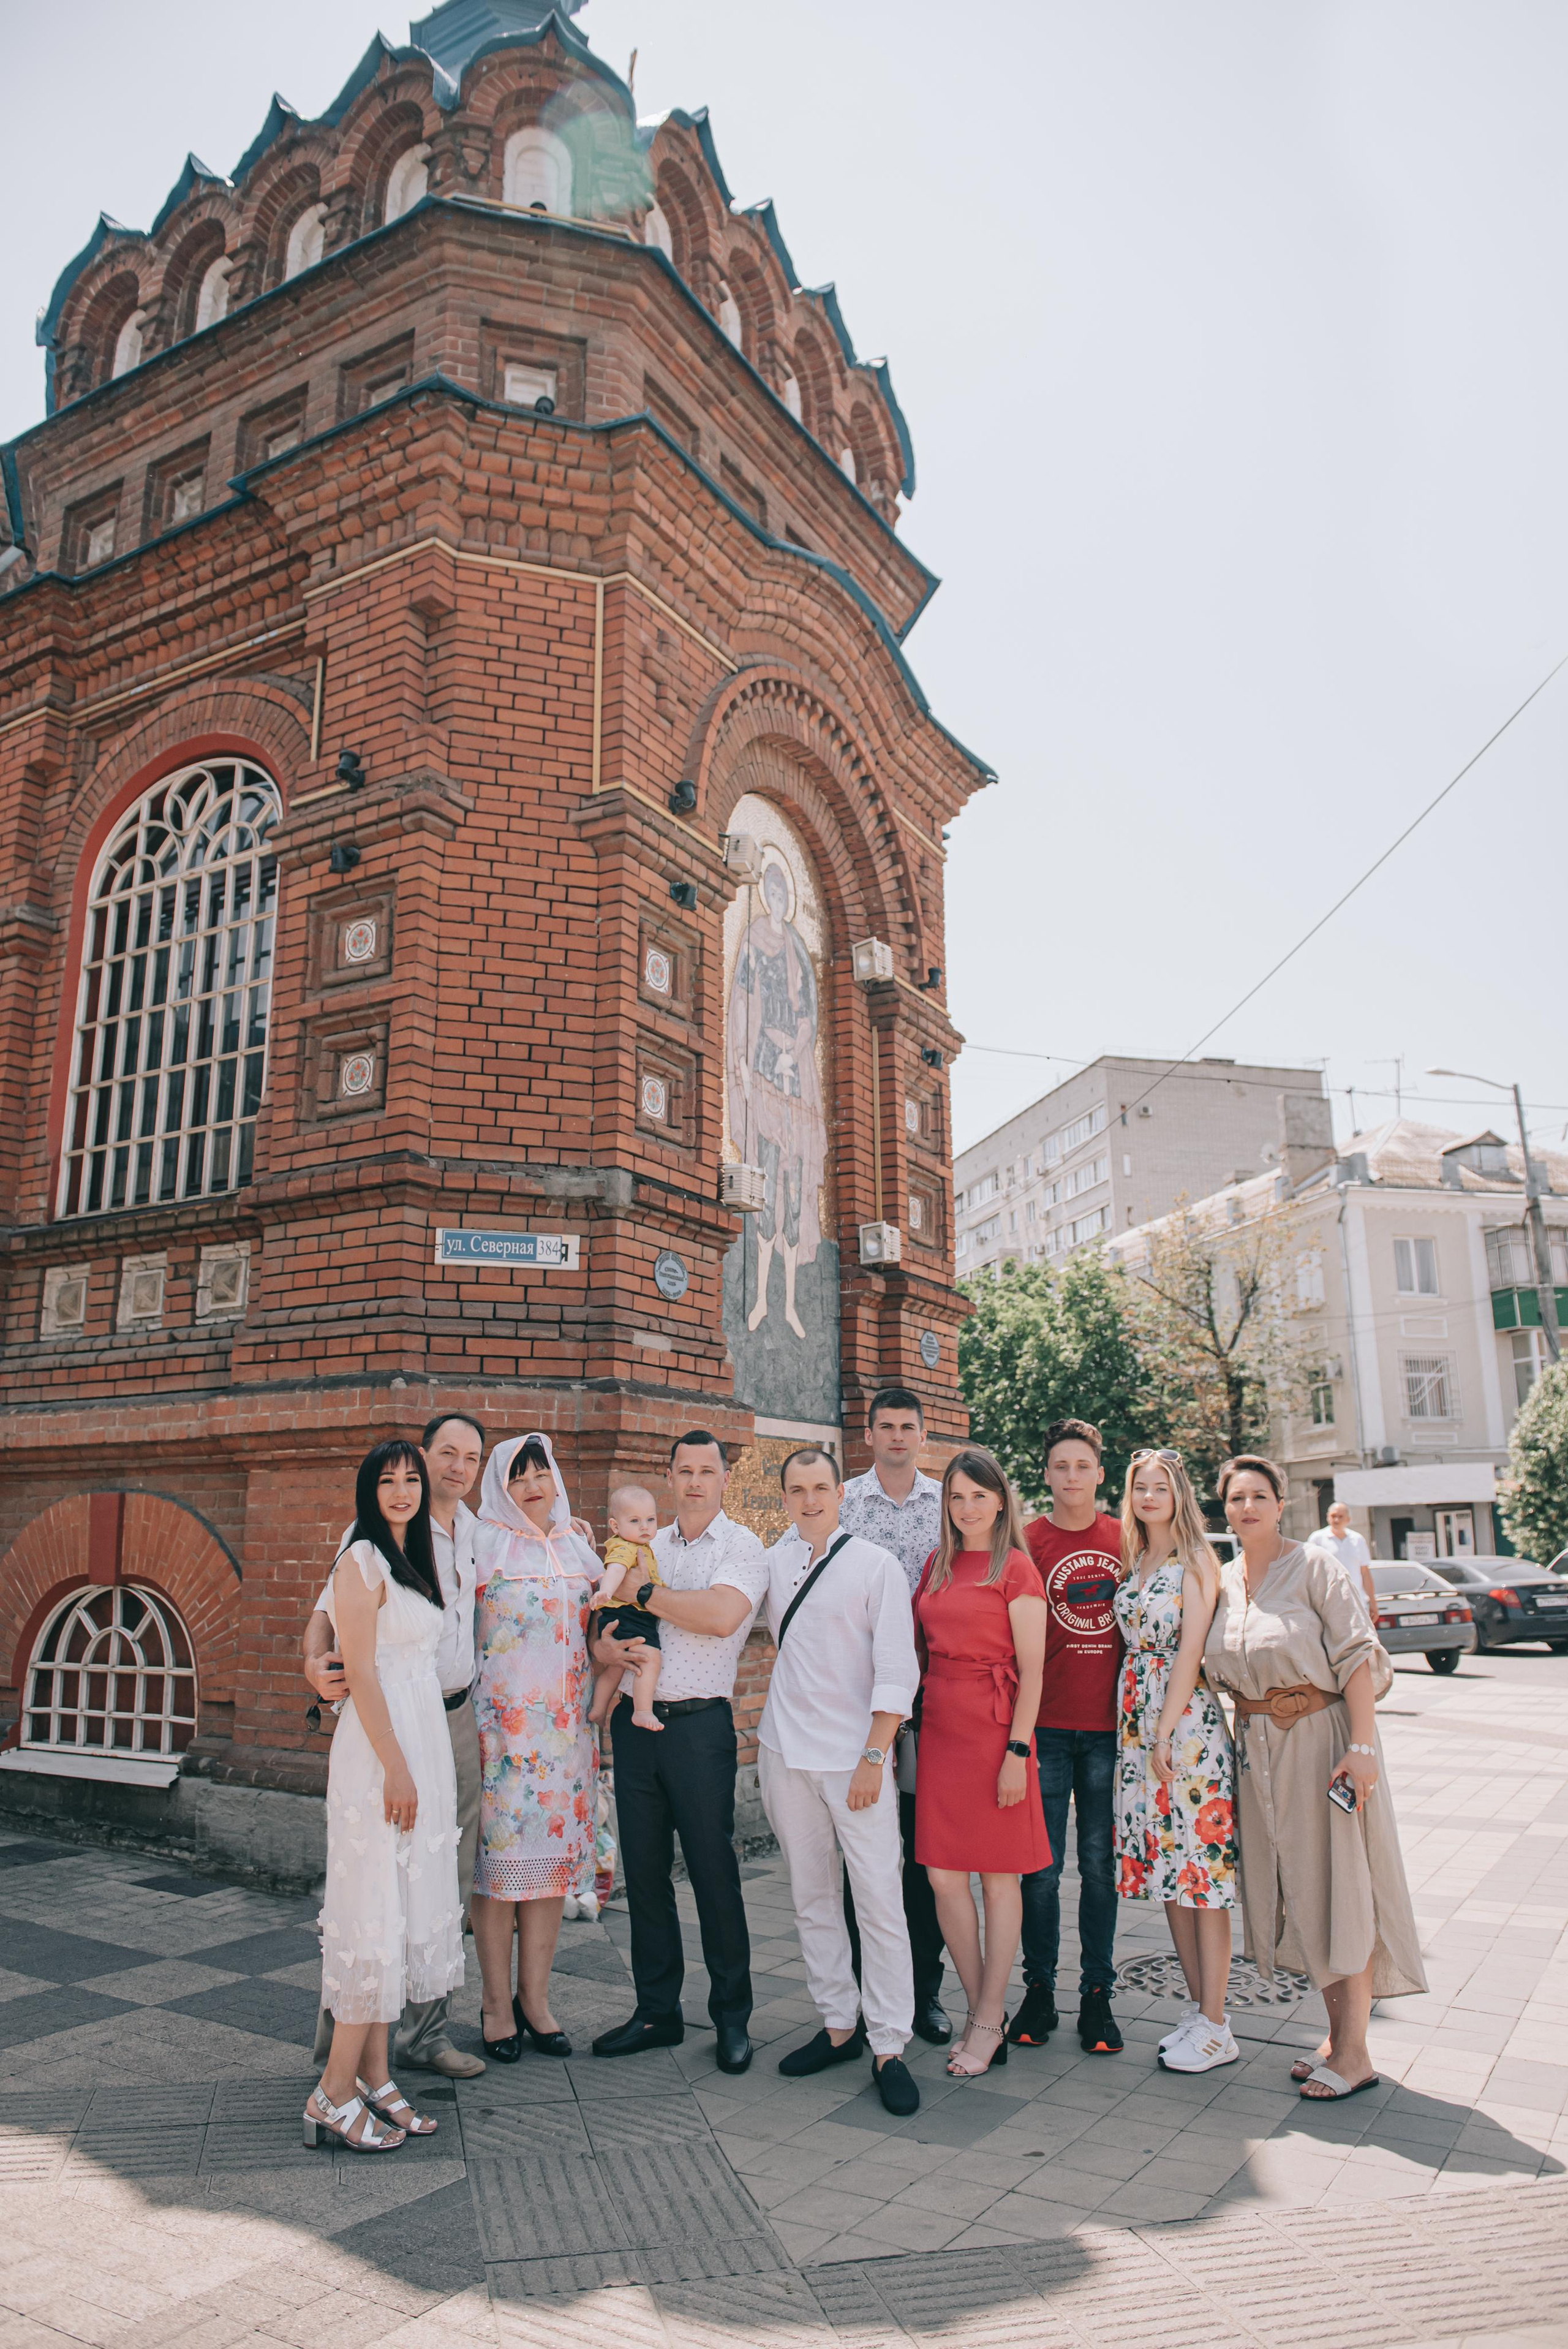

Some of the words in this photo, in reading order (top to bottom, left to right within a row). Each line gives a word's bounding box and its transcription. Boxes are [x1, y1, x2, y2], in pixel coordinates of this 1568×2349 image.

[446, 1239, 466, 1255] ул.
[470, 1235, 534, 1258] Северная
[538, 1240, 559, 1256] 384
[1053, 1556, 1095, 1590] MUSTANG
[1056, 1602, 1096, 1629] ORIGINAL
[1097, 1609, 1115, 1627] BRA
